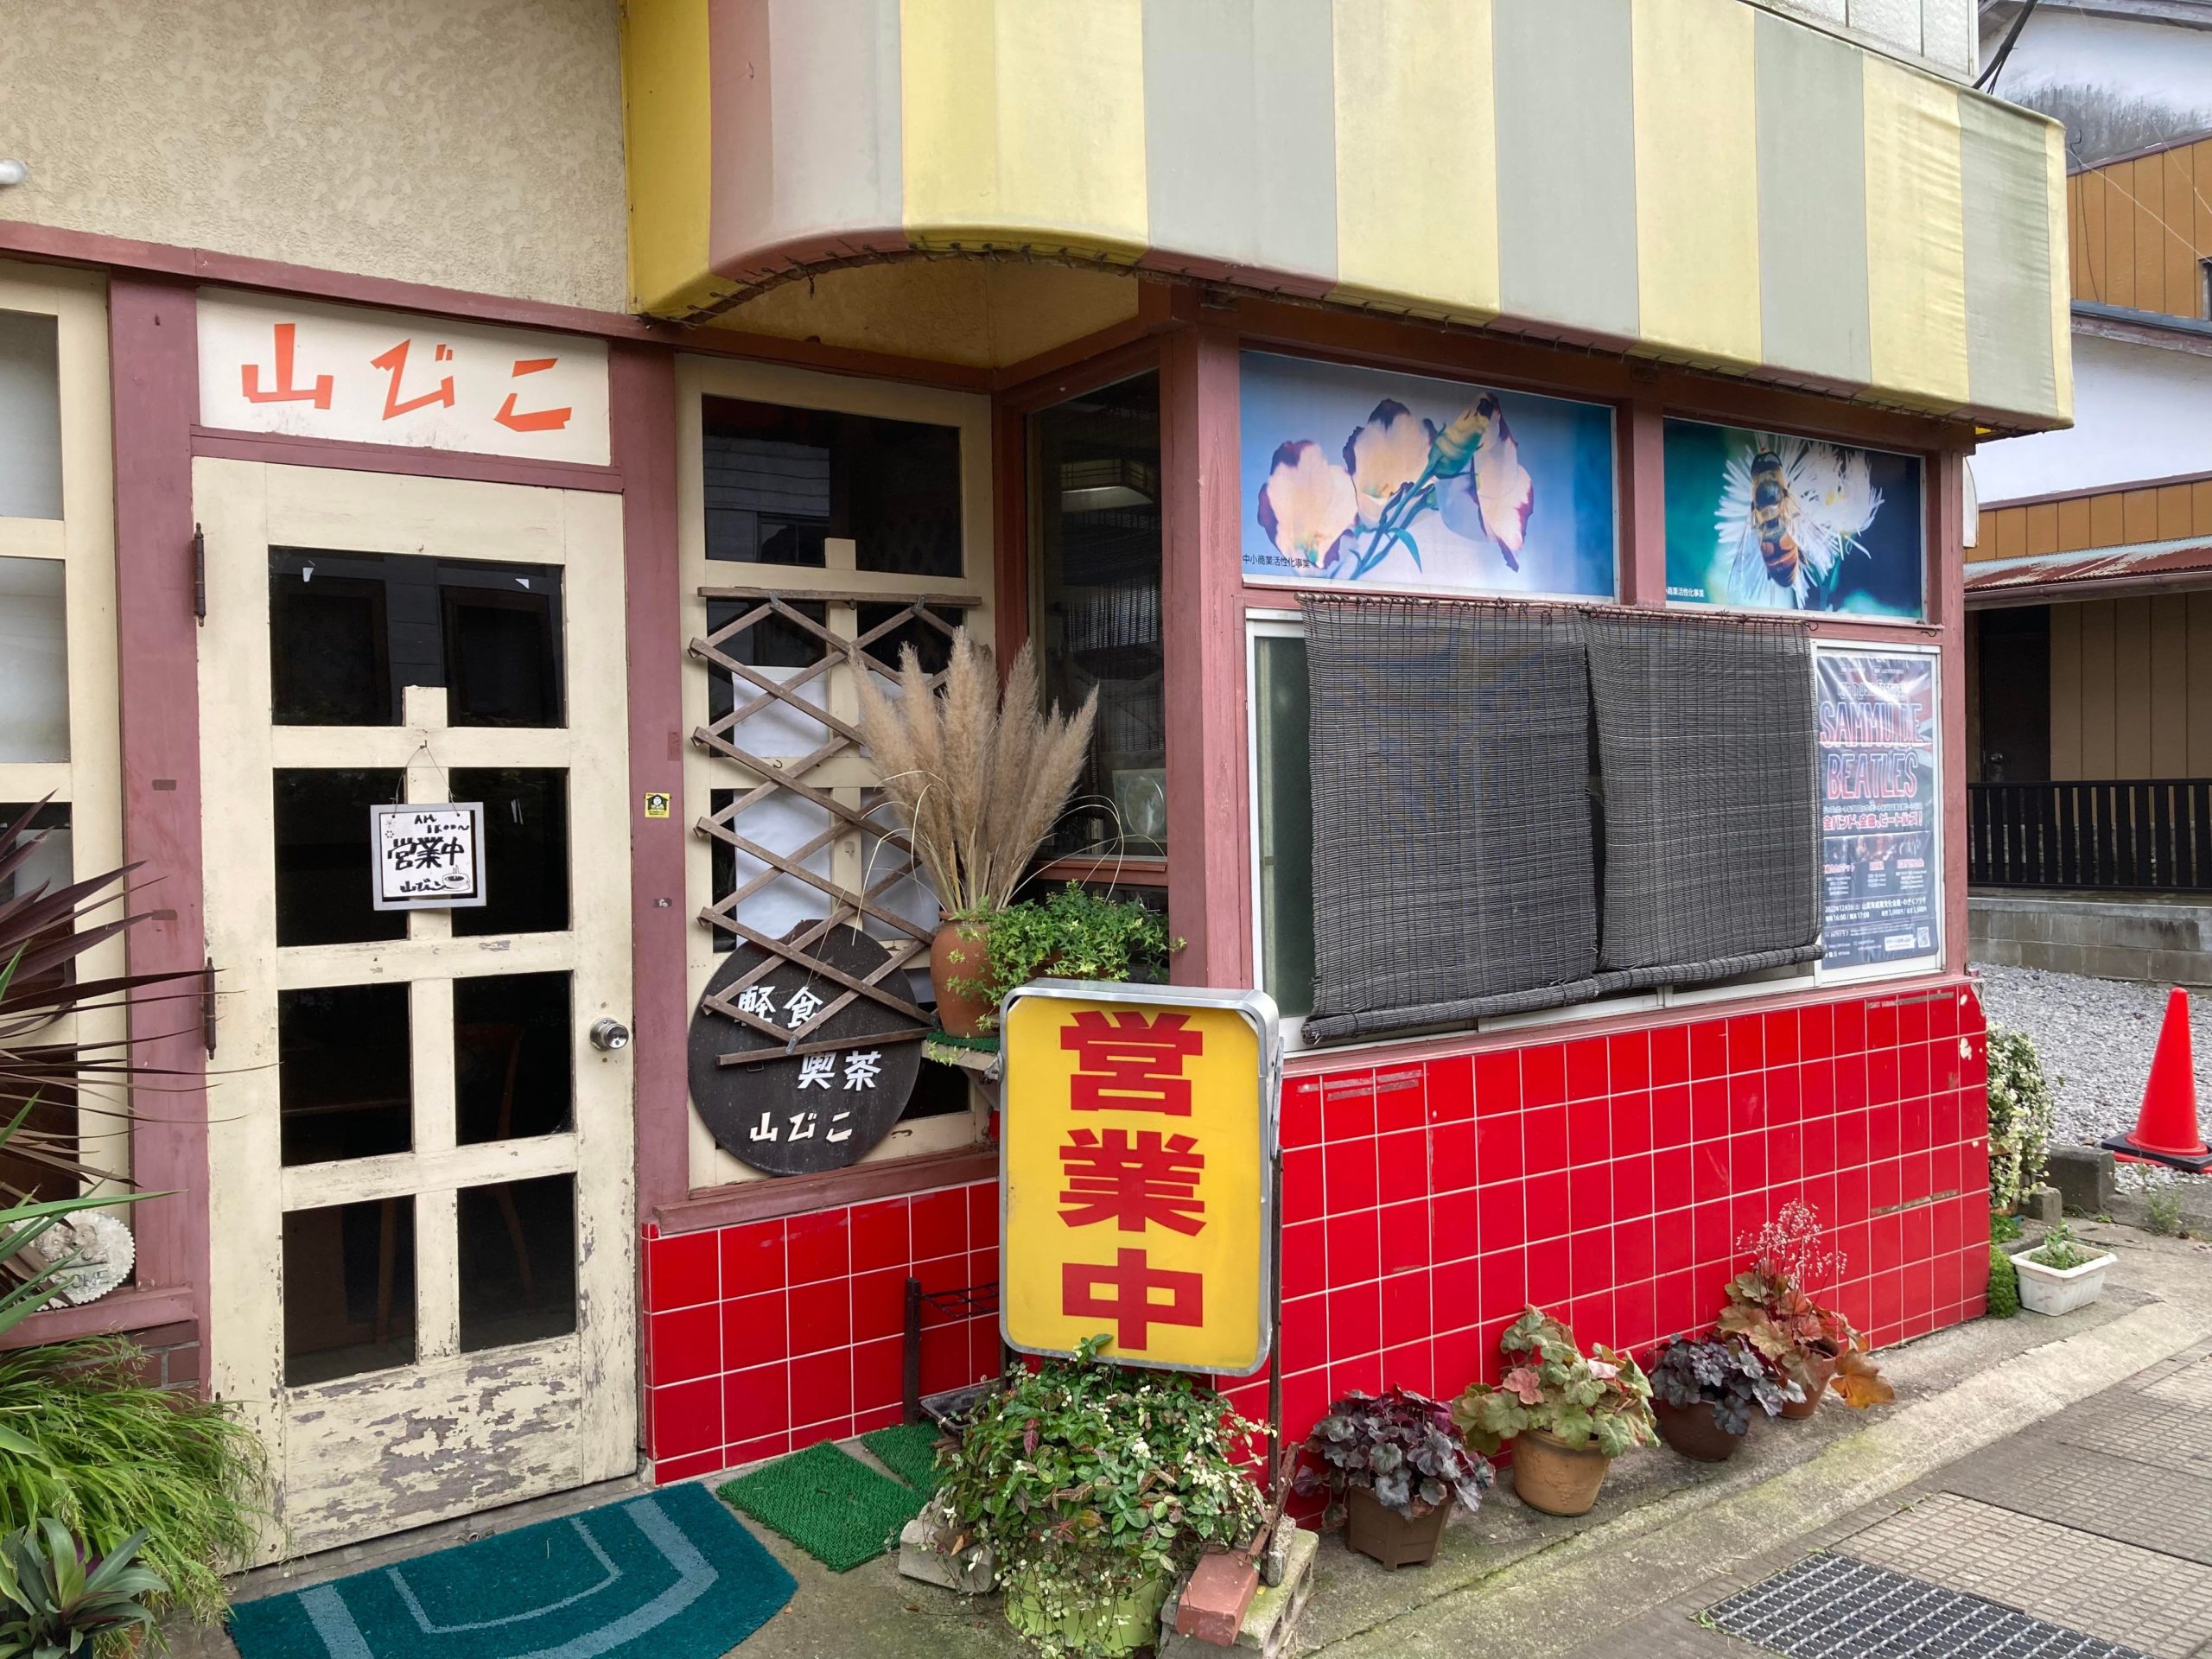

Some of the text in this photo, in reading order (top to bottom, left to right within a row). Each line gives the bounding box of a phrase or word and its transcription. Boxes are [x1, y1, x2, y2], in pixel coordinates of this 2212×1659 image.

[242, 322, 572, 432] 山びこ
[1243, 554, 1311, 569] 中小商業活性化事業
[1666, 587, 1705, 598] 商業活性化事業
[1819, 701, 1895, 748] SAMMU
[1827, 752, 1918, 799] BEATLES
[414, 814, 437, 824] AM
[387, 836, 465, 870] 営業中
[400, 878, 448, 893] 山びこ
[736, 985, 823, 1029] 軽食
[797, 1050, 882, 1091] 喫茶
[749, 1111, 853, 1143] 山びこ
[1057, 1010, 1207, 1351] 営業中
